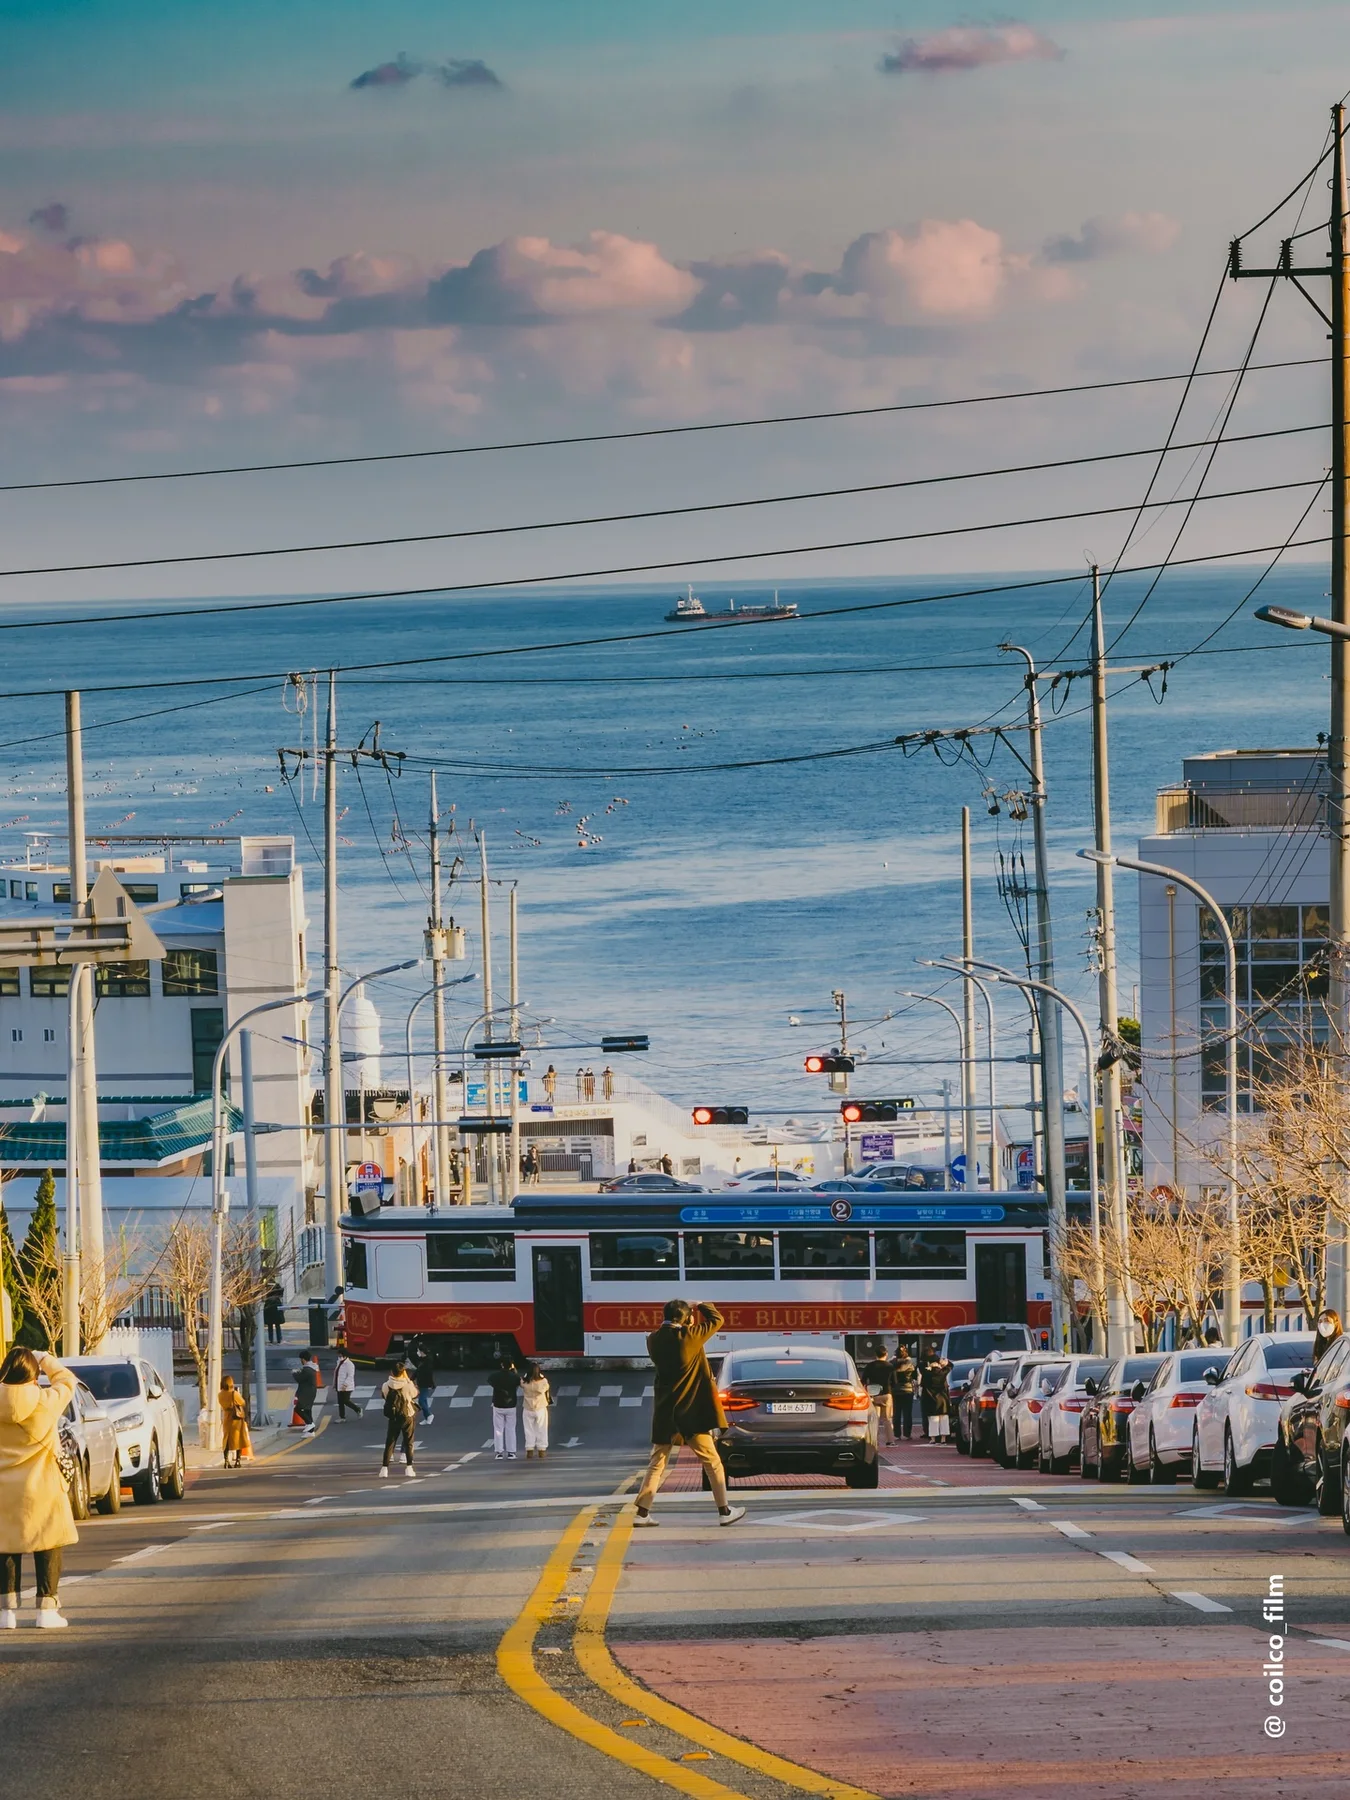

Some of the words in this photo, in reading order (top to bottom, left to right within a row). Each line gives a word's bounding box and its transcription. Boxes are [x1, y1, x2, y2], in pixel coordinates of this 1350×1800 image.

[836, 1202, 848, 1218] 2
[756, 1310, 863, 1327] BLUELINE
[877, 1310, 942, 1327] PARK
